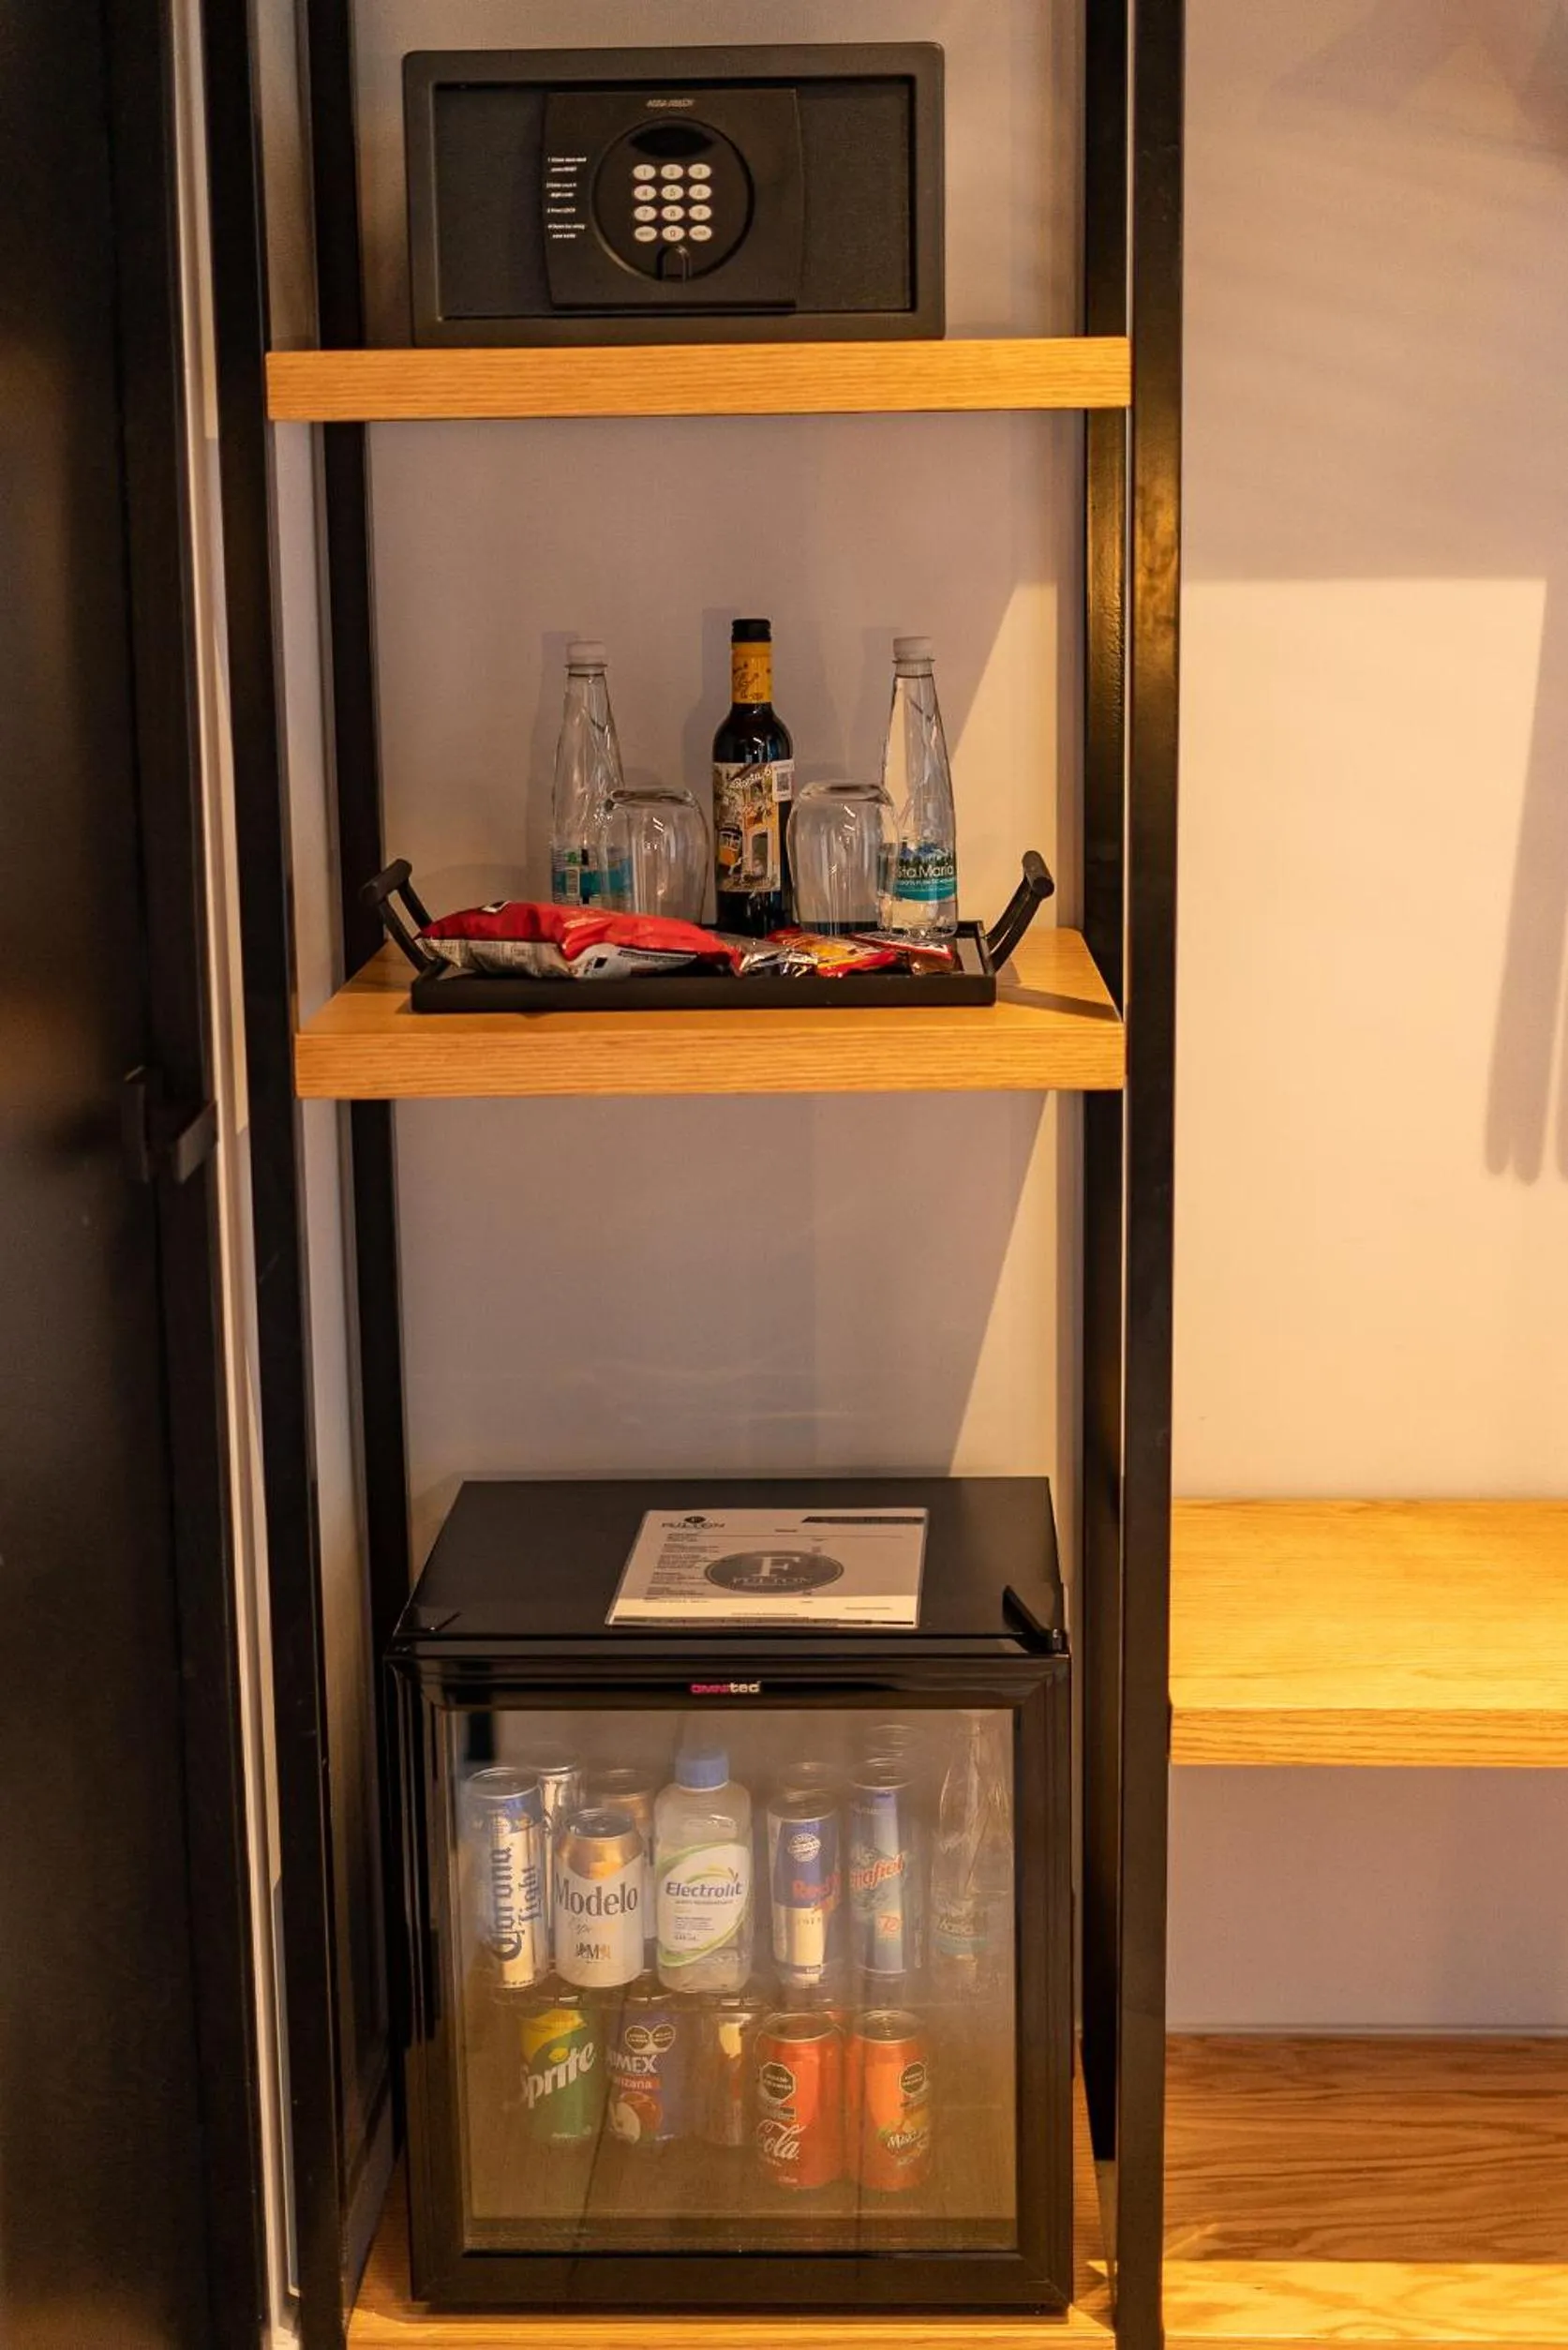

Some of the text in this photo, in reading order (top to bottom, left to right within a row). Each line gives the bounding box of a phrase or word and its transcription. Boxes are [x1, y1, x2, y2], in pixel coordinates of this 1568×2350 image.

[489, 1846, 525, 1962] Corona
[556, 1871, 638, 1916] Modelo
[666, 1881, 743, 1898] Electrolit
[521, 2042, 595, 2109] Sprite
